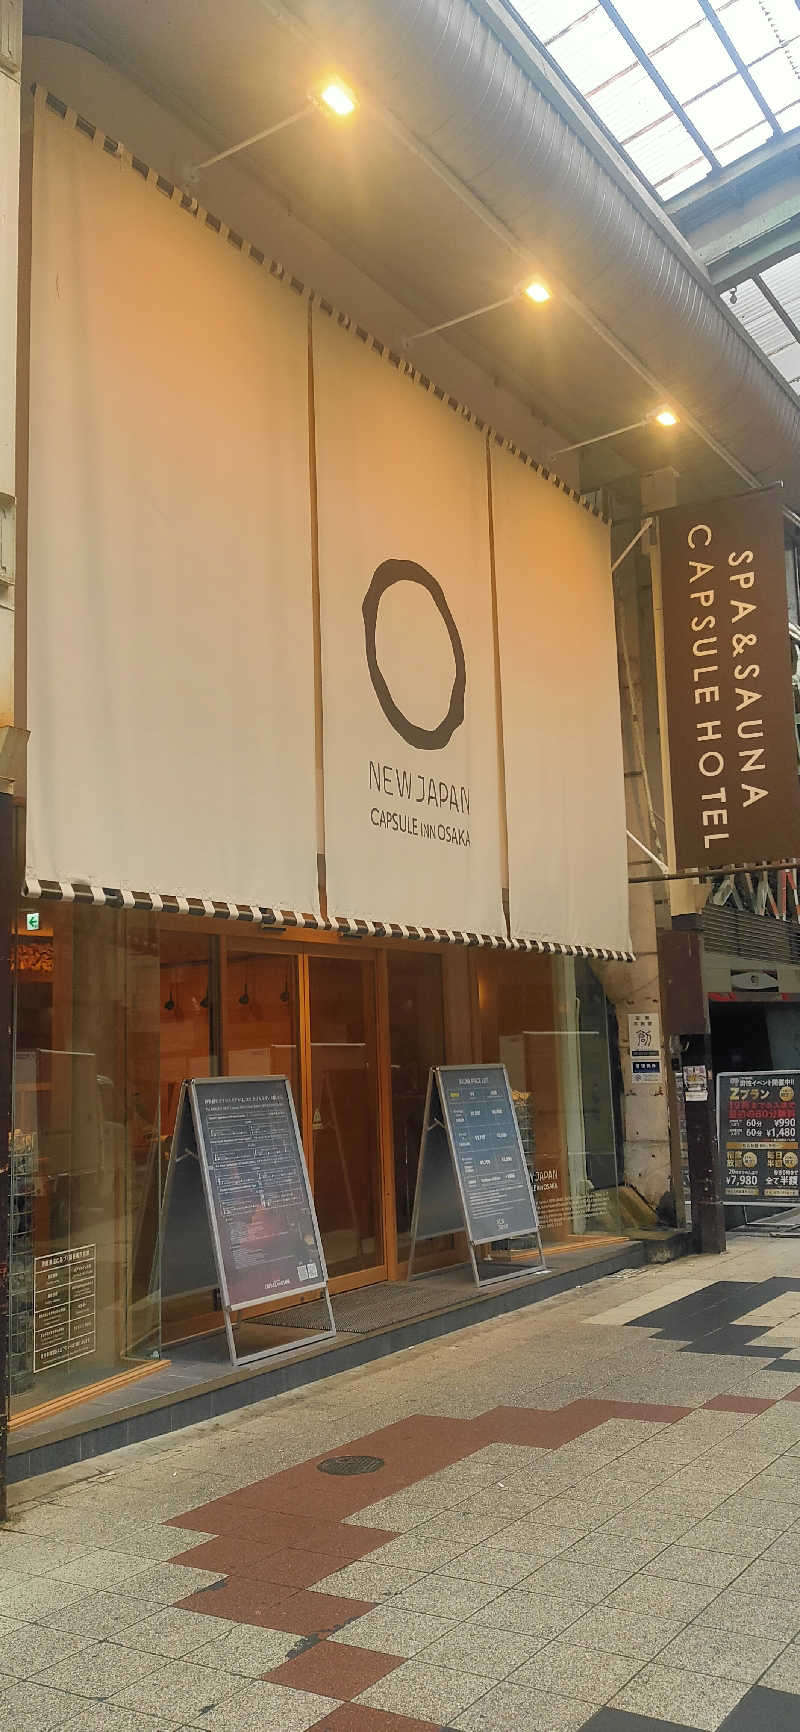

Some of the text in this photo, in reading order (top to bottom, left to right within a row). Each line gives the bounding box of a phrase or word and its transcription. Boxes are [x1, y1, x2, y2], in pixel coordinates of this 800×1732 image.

[687, 524, 730, 849] CAPSULE HOTEL
[728, 550, 769, 808] SPA&SAUNA
[369, 760, 471, 816] NEW JAPAN
[370, 807, 471, 848] CAPSULE INN OSAKA
[766, 1127, 796, 1138] ¥1,480
[774, 1118, 796, 1127] ¥990
[726, 1175, 758, 1186] ¥7,980
